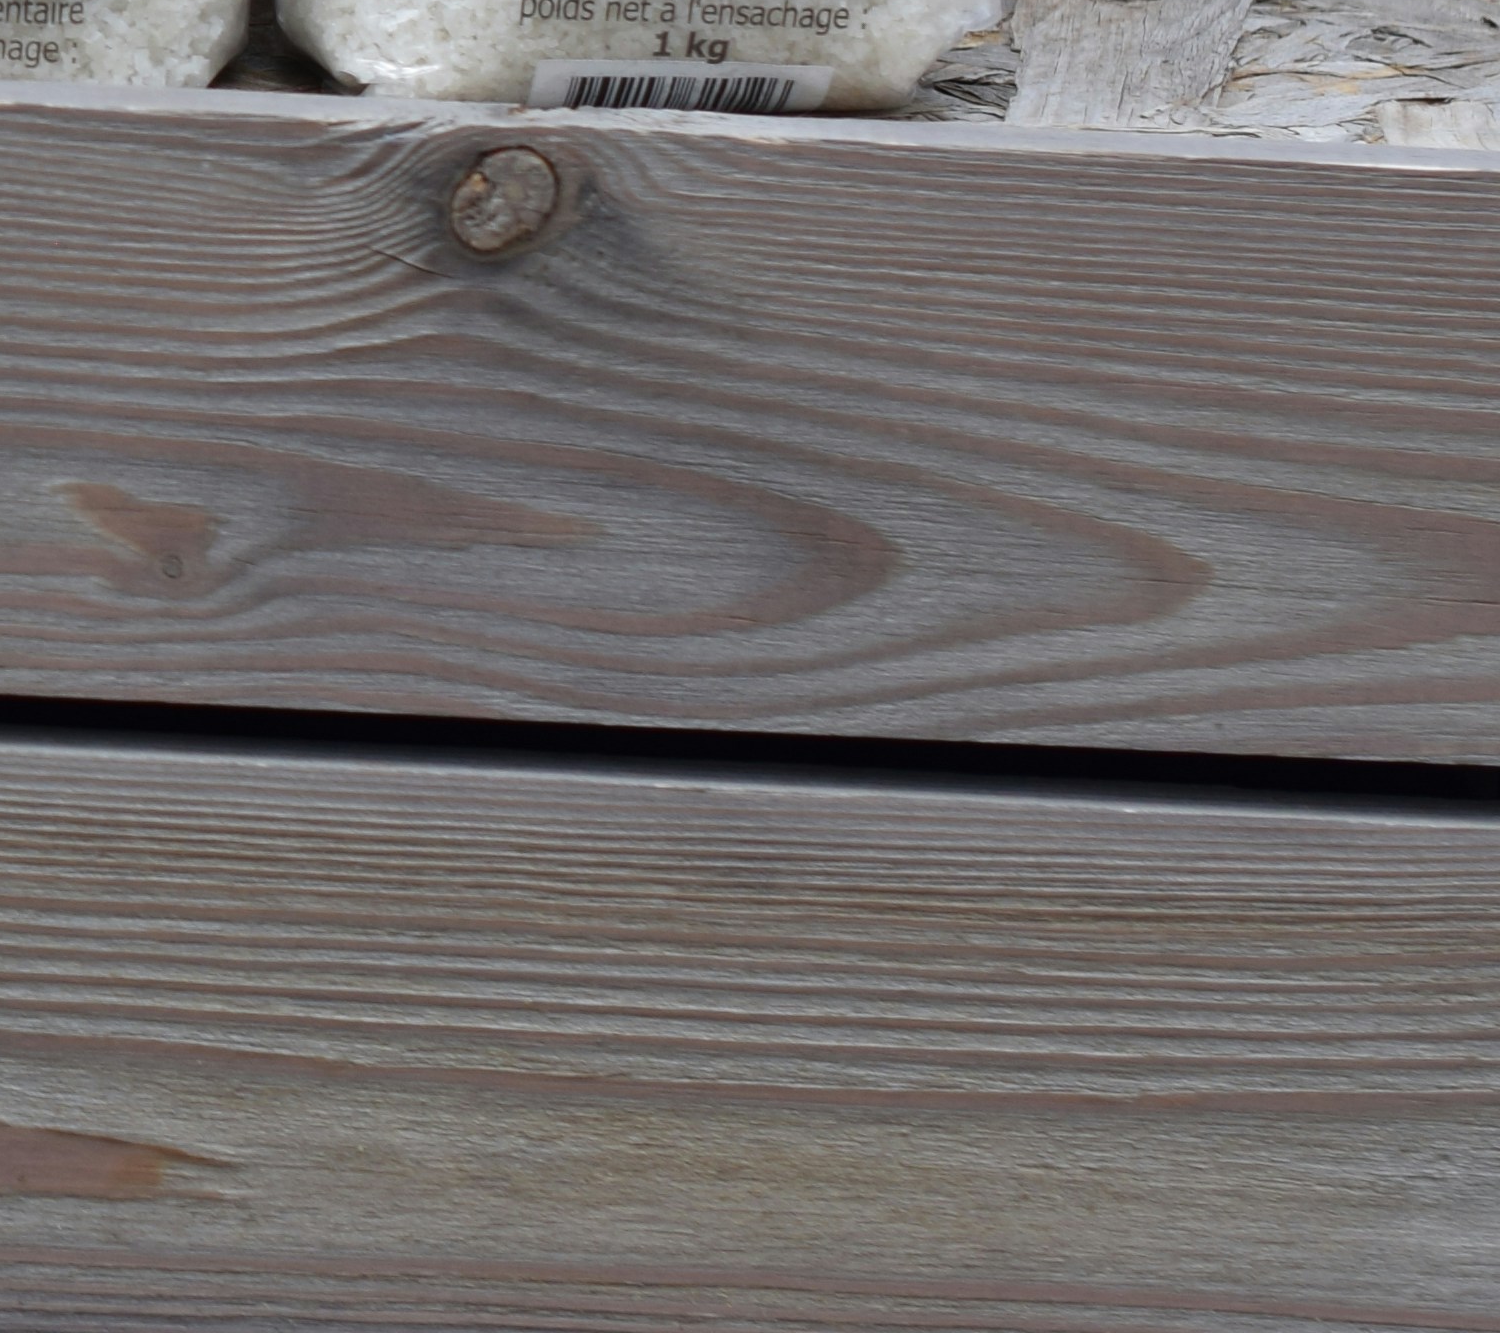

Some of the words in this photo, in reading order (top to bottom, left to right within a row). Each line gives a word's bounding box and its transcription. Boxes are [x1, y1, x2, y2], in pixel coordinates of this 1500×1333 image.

[606, 0, 651, 22] net
[653, 32, 671, 57] 1
[686, 32, 729, 64] kg
